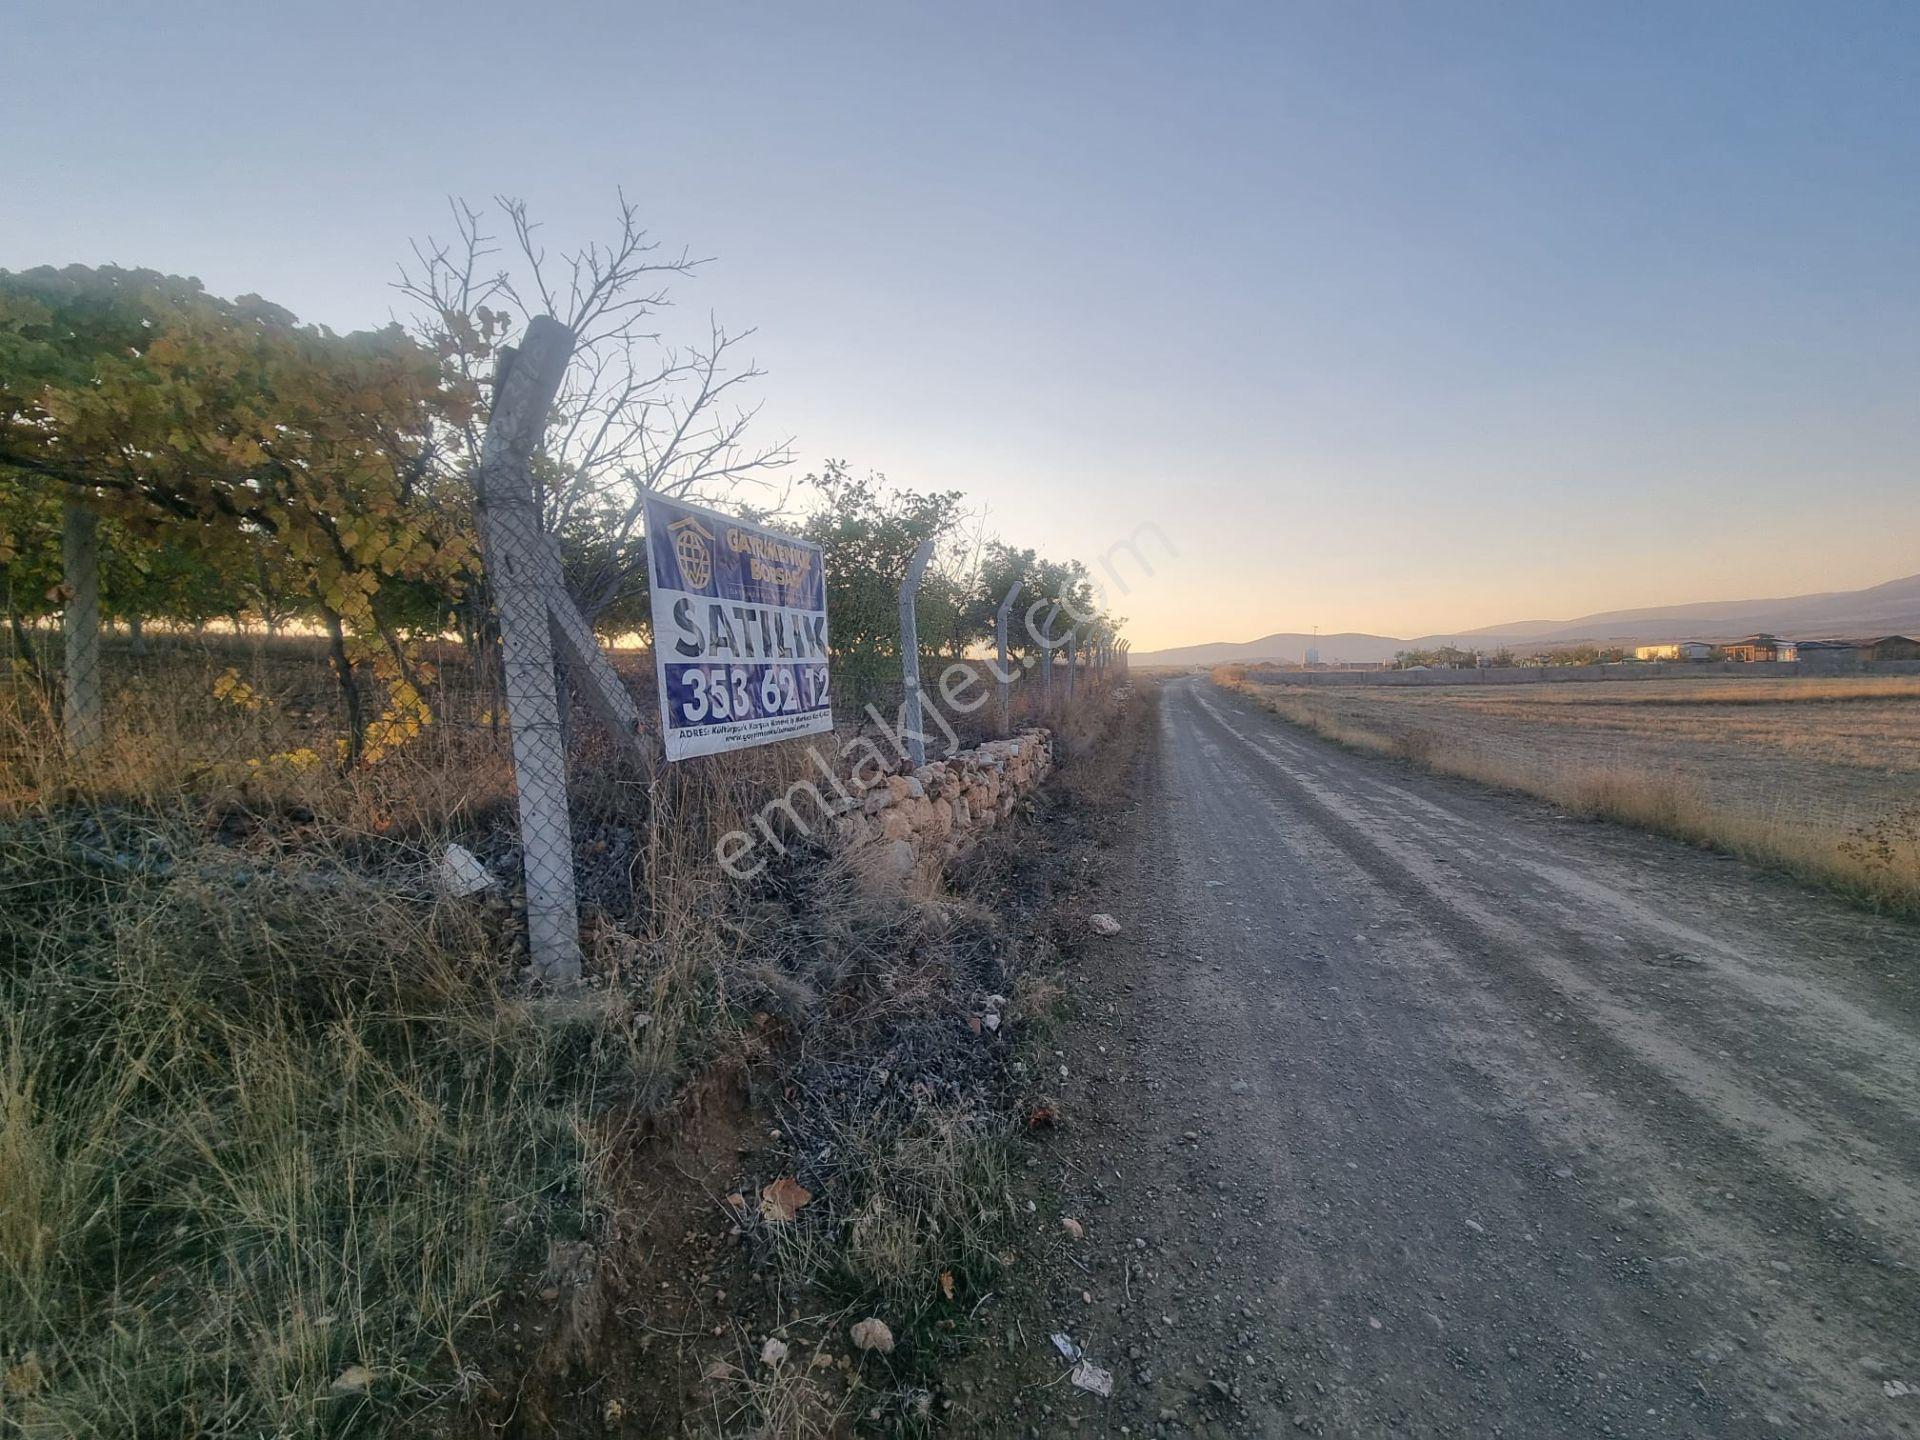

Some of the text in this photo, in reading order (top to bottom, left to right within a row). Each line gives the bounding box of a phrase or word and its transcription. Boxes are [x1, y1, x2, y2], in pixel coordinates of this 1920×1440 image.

[673, 597, 828, 657] SATILIK
[681, 667, 829, 721] 353 62 12
[679, 728, 710, 739] ADRES:
